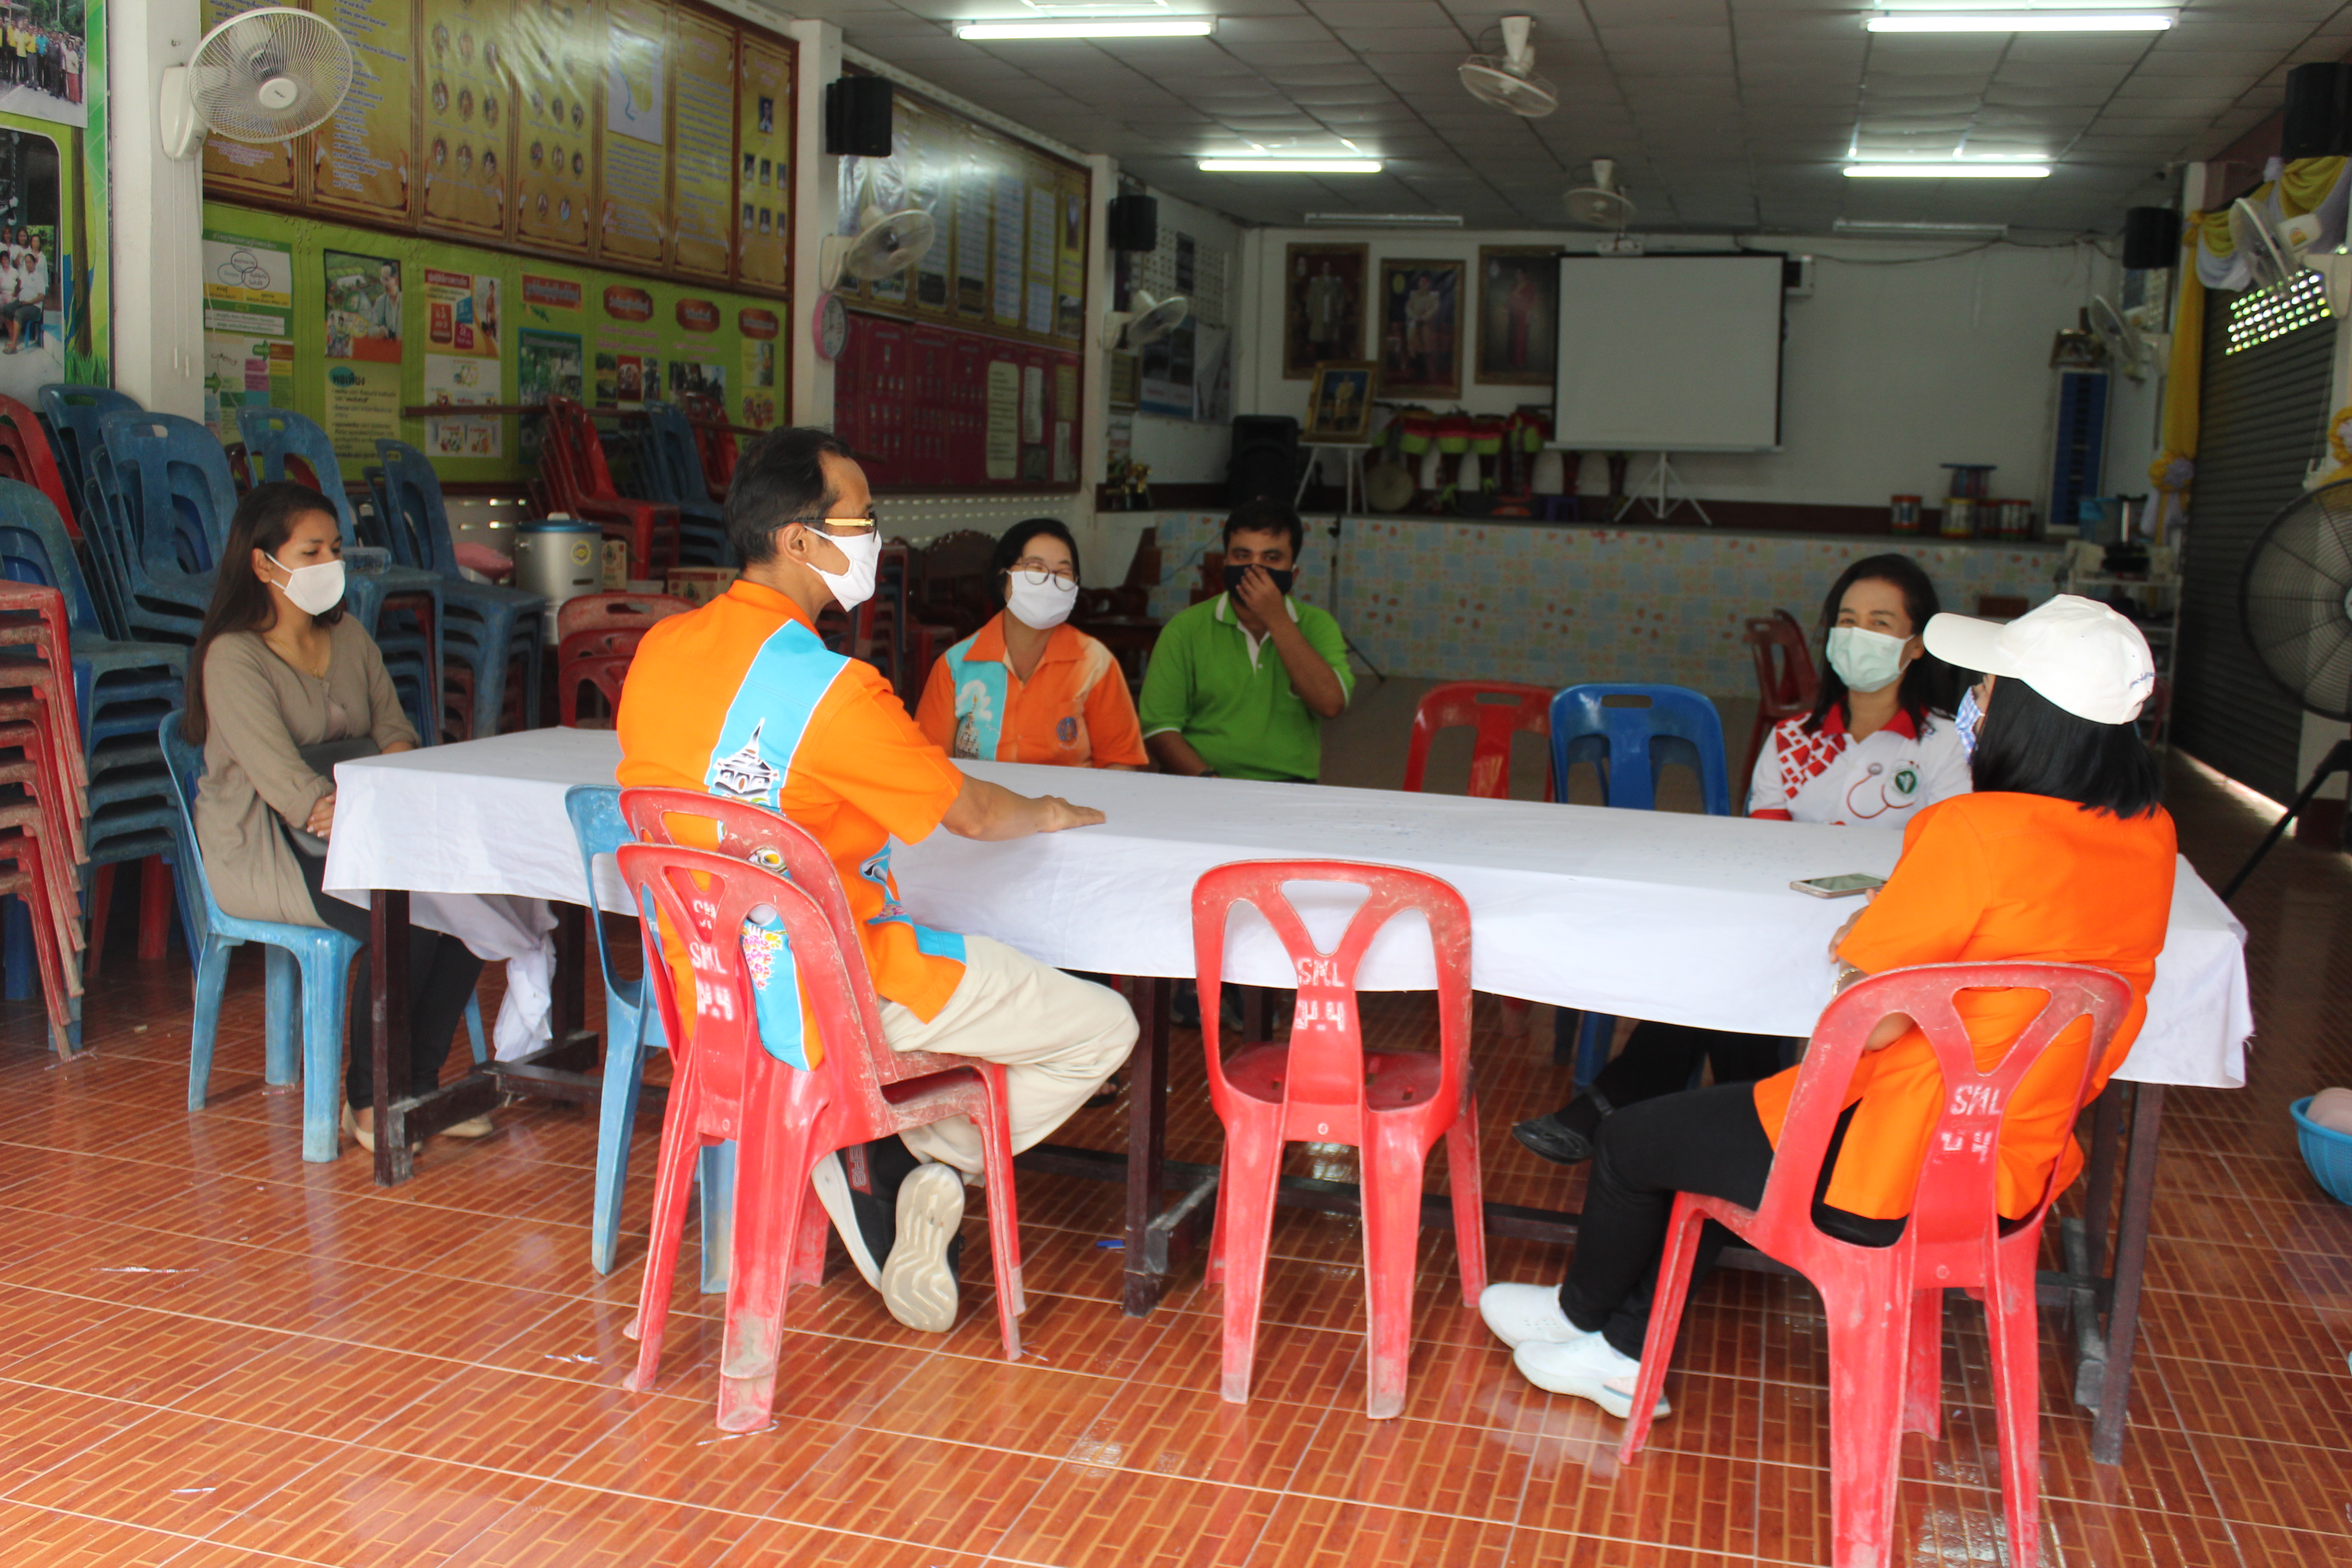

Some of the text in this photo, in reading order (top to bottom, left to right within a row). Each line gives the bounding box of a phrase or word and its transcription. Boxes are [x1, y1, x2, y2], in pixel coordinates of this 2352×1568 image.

[689, 942, 727, 975] SML
[1297, 958, 1345, 987] SML
[1950, 1084, 2000, 1116] SML
